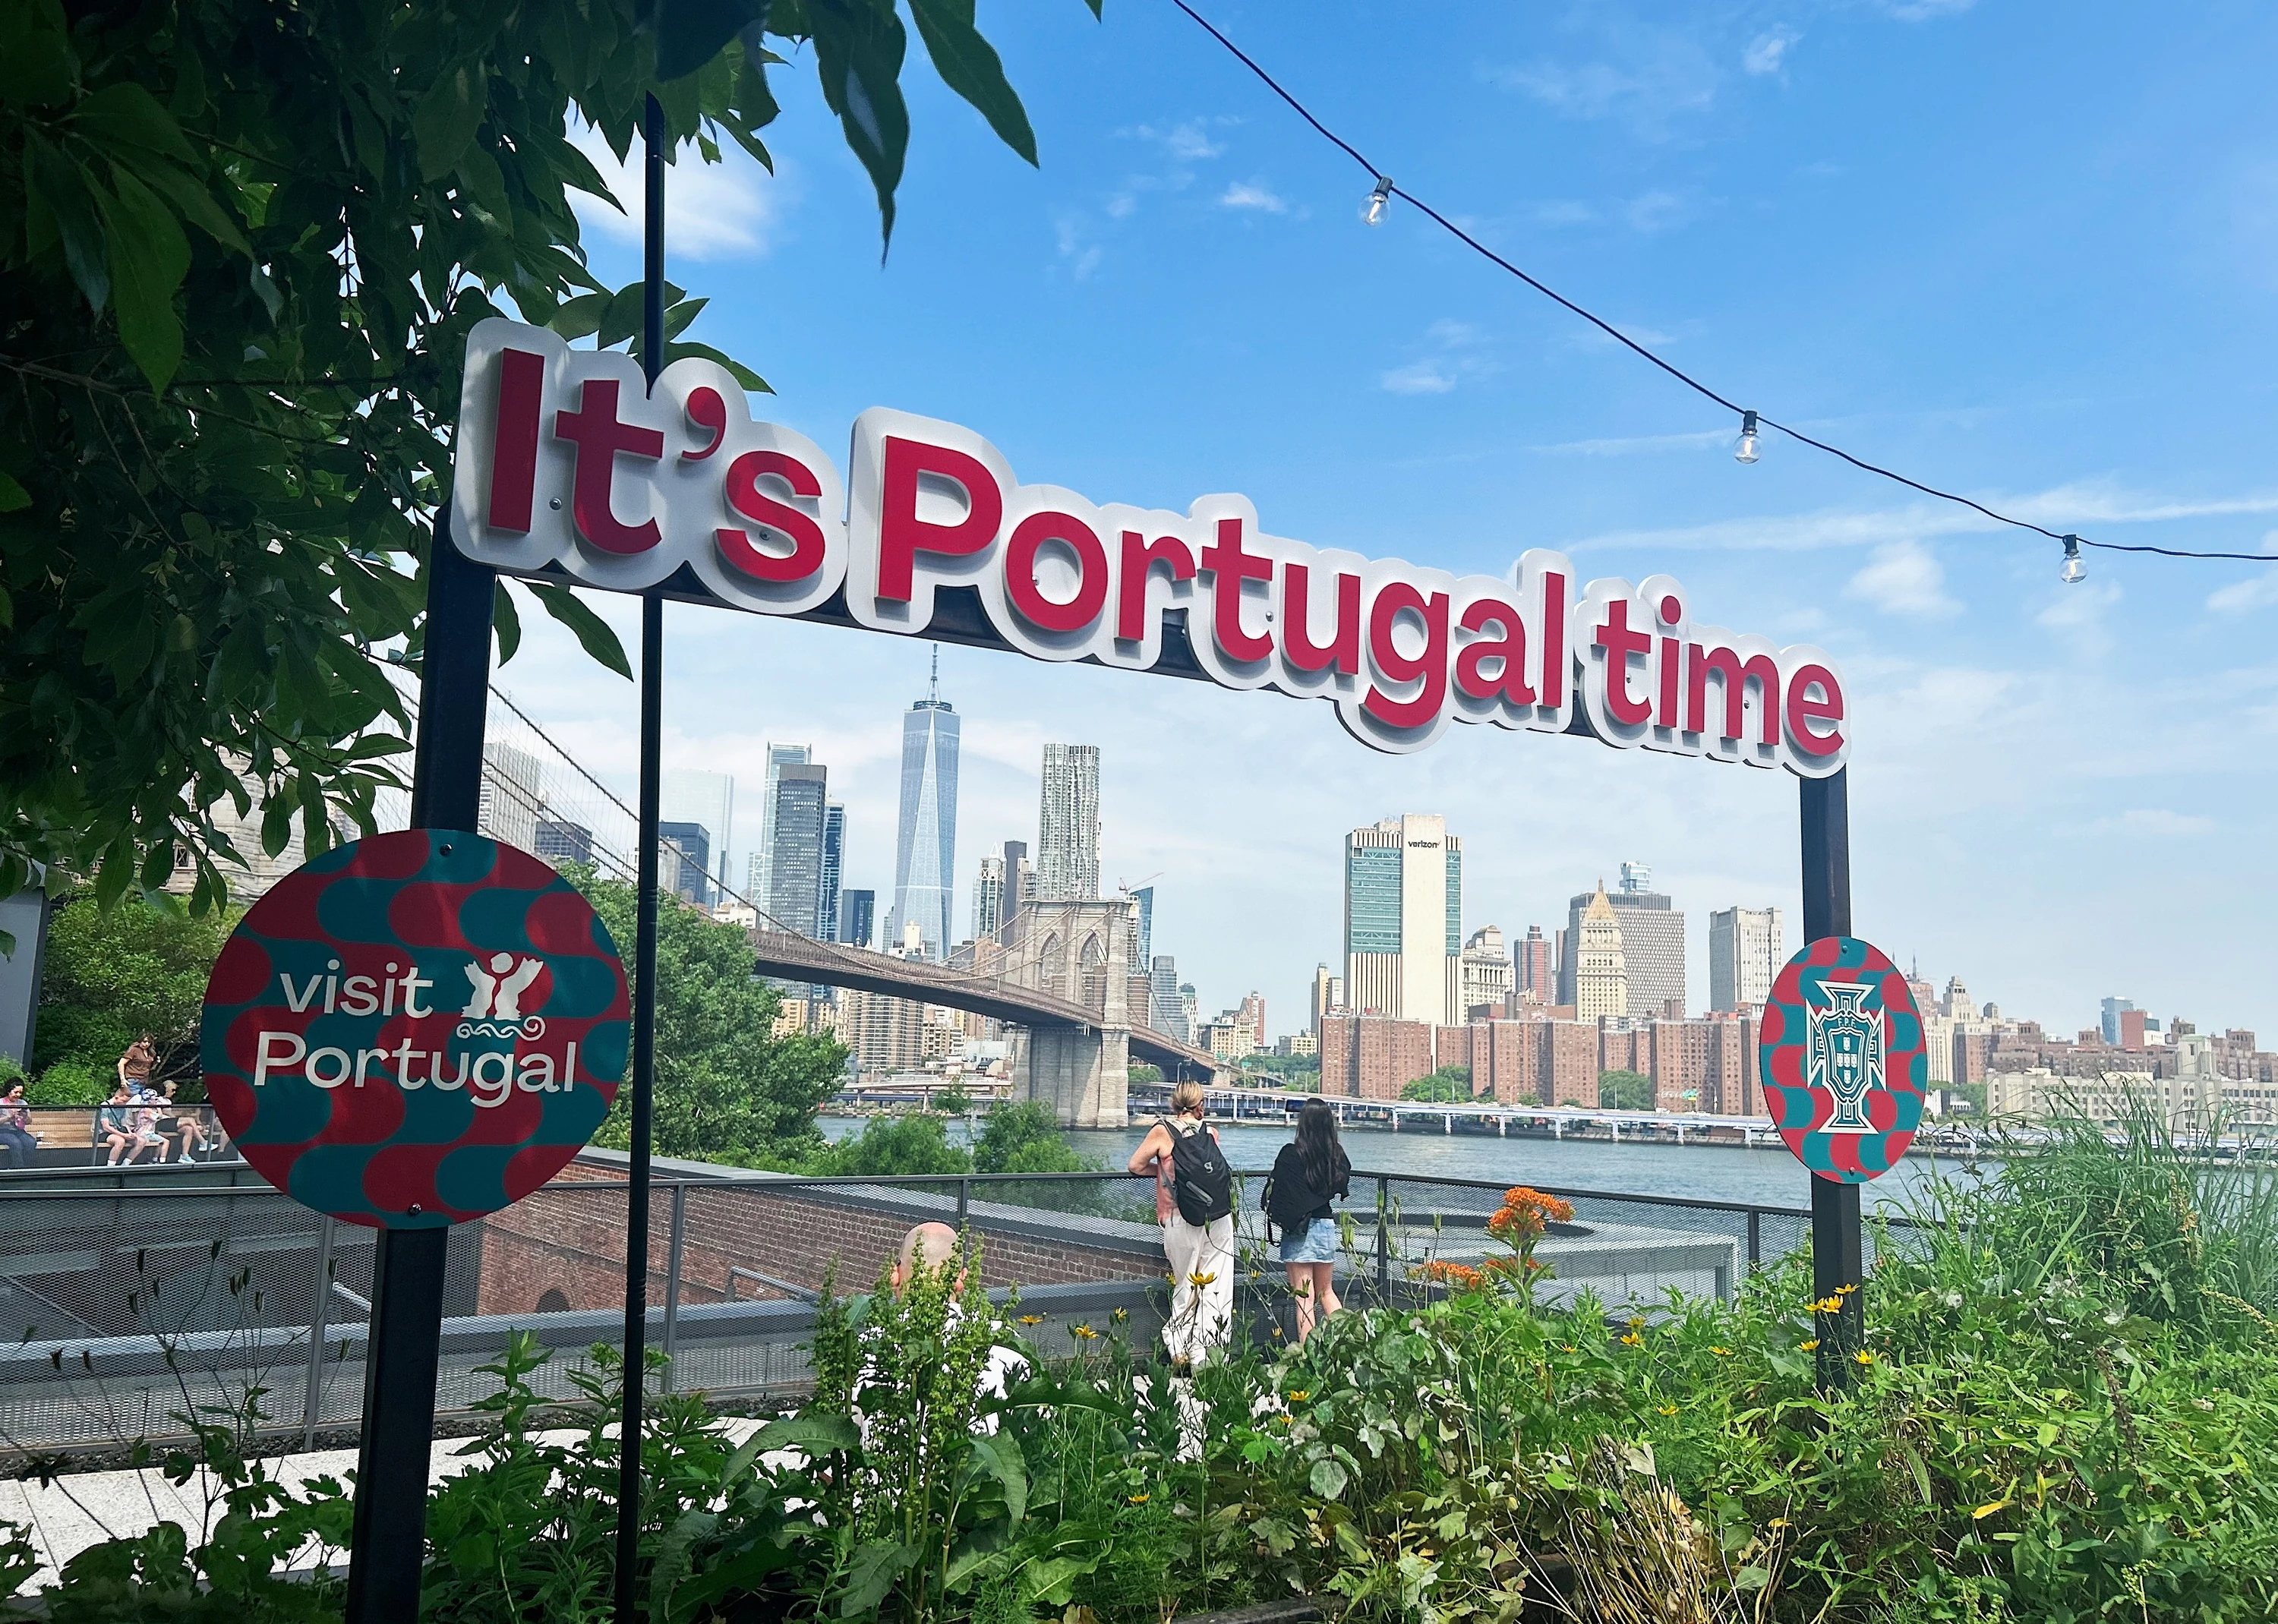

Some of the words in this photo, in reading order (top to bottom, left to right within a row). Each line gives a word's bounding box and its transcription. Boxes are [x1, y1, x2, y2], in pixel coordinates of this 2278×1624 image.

[487, 346, 826, 582] It's
[876, 435, 1566, 728] Portugal
[1595, 599, 1844, 755] time
[1407, 840, 1438, 849] verizon
[279, 958, 434, 1019] visit
[253, 1030, 577, 1108] Portugal
